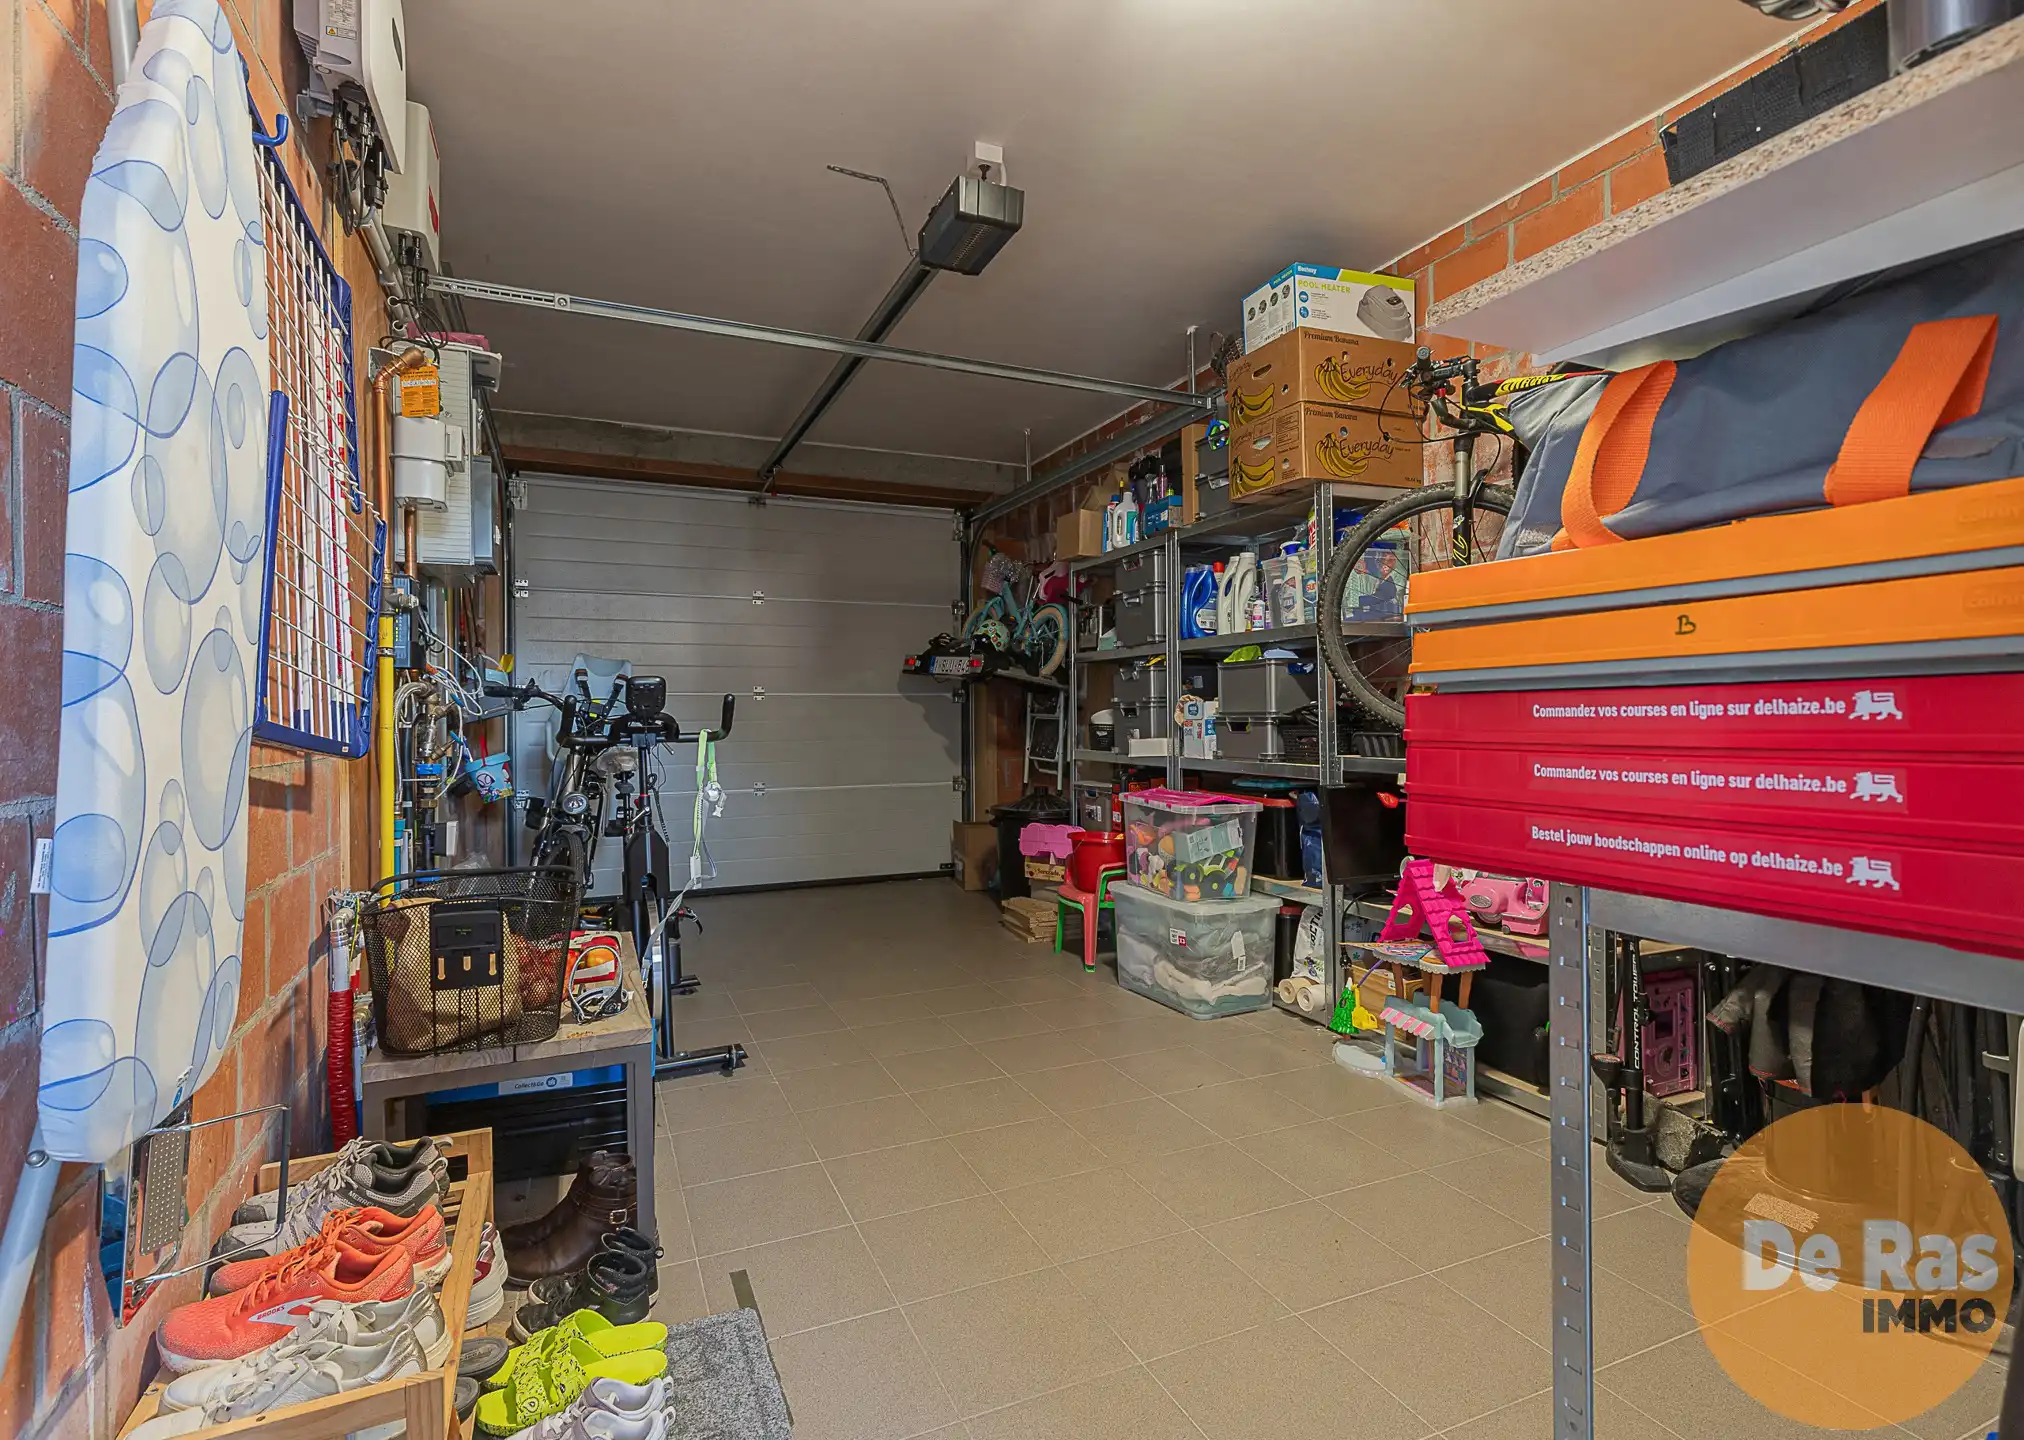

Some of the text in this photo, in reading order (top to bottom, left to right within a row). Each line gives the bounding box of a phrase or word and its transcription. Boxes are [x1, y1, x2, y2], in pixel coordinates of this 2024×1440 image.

[1297, 279, 1352, 294] POOL HEATER
[1304, 331, 1360, 346] Premium Banana
[1340, 361, 1398, 386] Everyday
[1304, 406, 1358, 421] Premium Banana
[1339, 436, 1395, 460] Everyday
[1675, 614, 1697, 636] B
[1533, 697, 1846, 720] Commandez vos courses en ligne sur delhaize.be
[1533, 763, 1847, 793] Commandez vos courses en ligne sur delhaize.be
[1531, 825, 1844, 877] Bestel jouw boodschappen online op delhaize.be
[1632, 1005, 1641, 1070] CONTROL
[348, 1190, 379, 1207] MERRE
[256, 1305, 286, 1320] BROOKS
